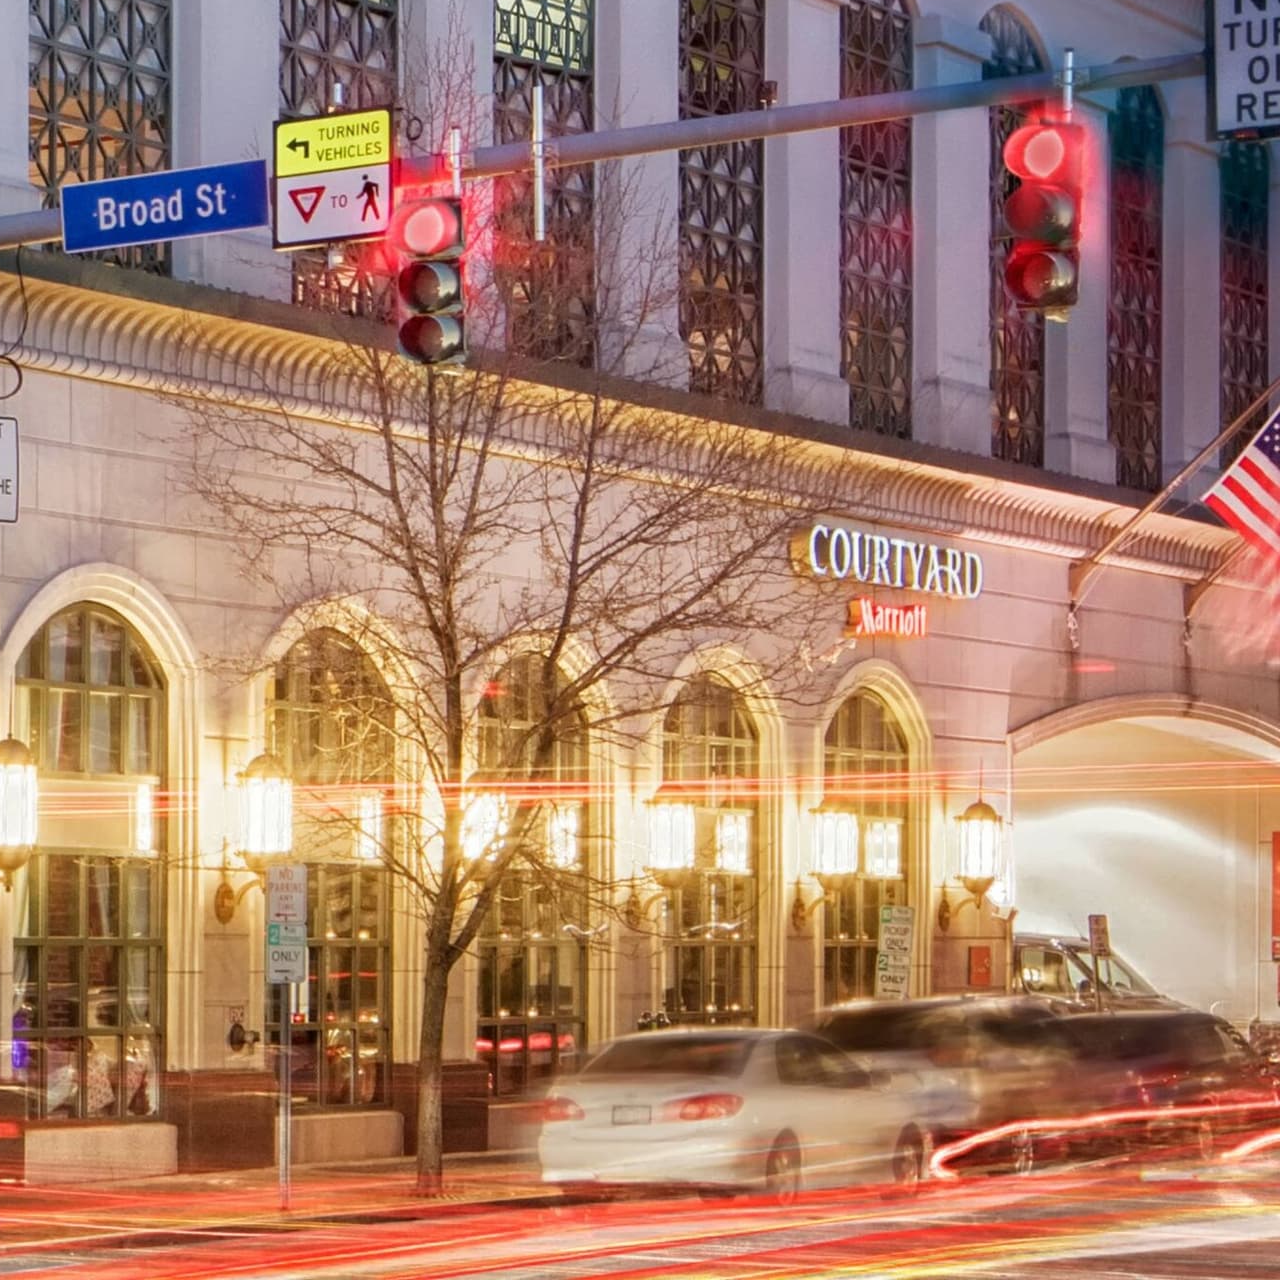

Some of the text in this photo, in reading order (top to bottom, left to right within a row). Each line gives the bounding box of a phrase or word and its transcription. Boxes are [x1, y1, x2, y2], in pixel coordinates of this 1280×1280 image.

[1222, 16, 1280, 51] TU
[1247, 55, 1280, 84] O
[1236, 91, 1280, 122] RE
[318, 120, 380, 141] TURNING
[315, 141, 382, 162] VEHICLES
[97, 183, 227, 231] Broad St
[330, 194, 348, 209] TO
[808, 524, 984, 599] COURTYARD
[855, 598, 928, 636] Marriott
[279, 868, 295, 880] NO
[270, 928, 279, 944] 2
[271, 950, 301, 961] ONLY
[879, 955, 889, 969] 2
[880, 974, 906, 985] ONLY
